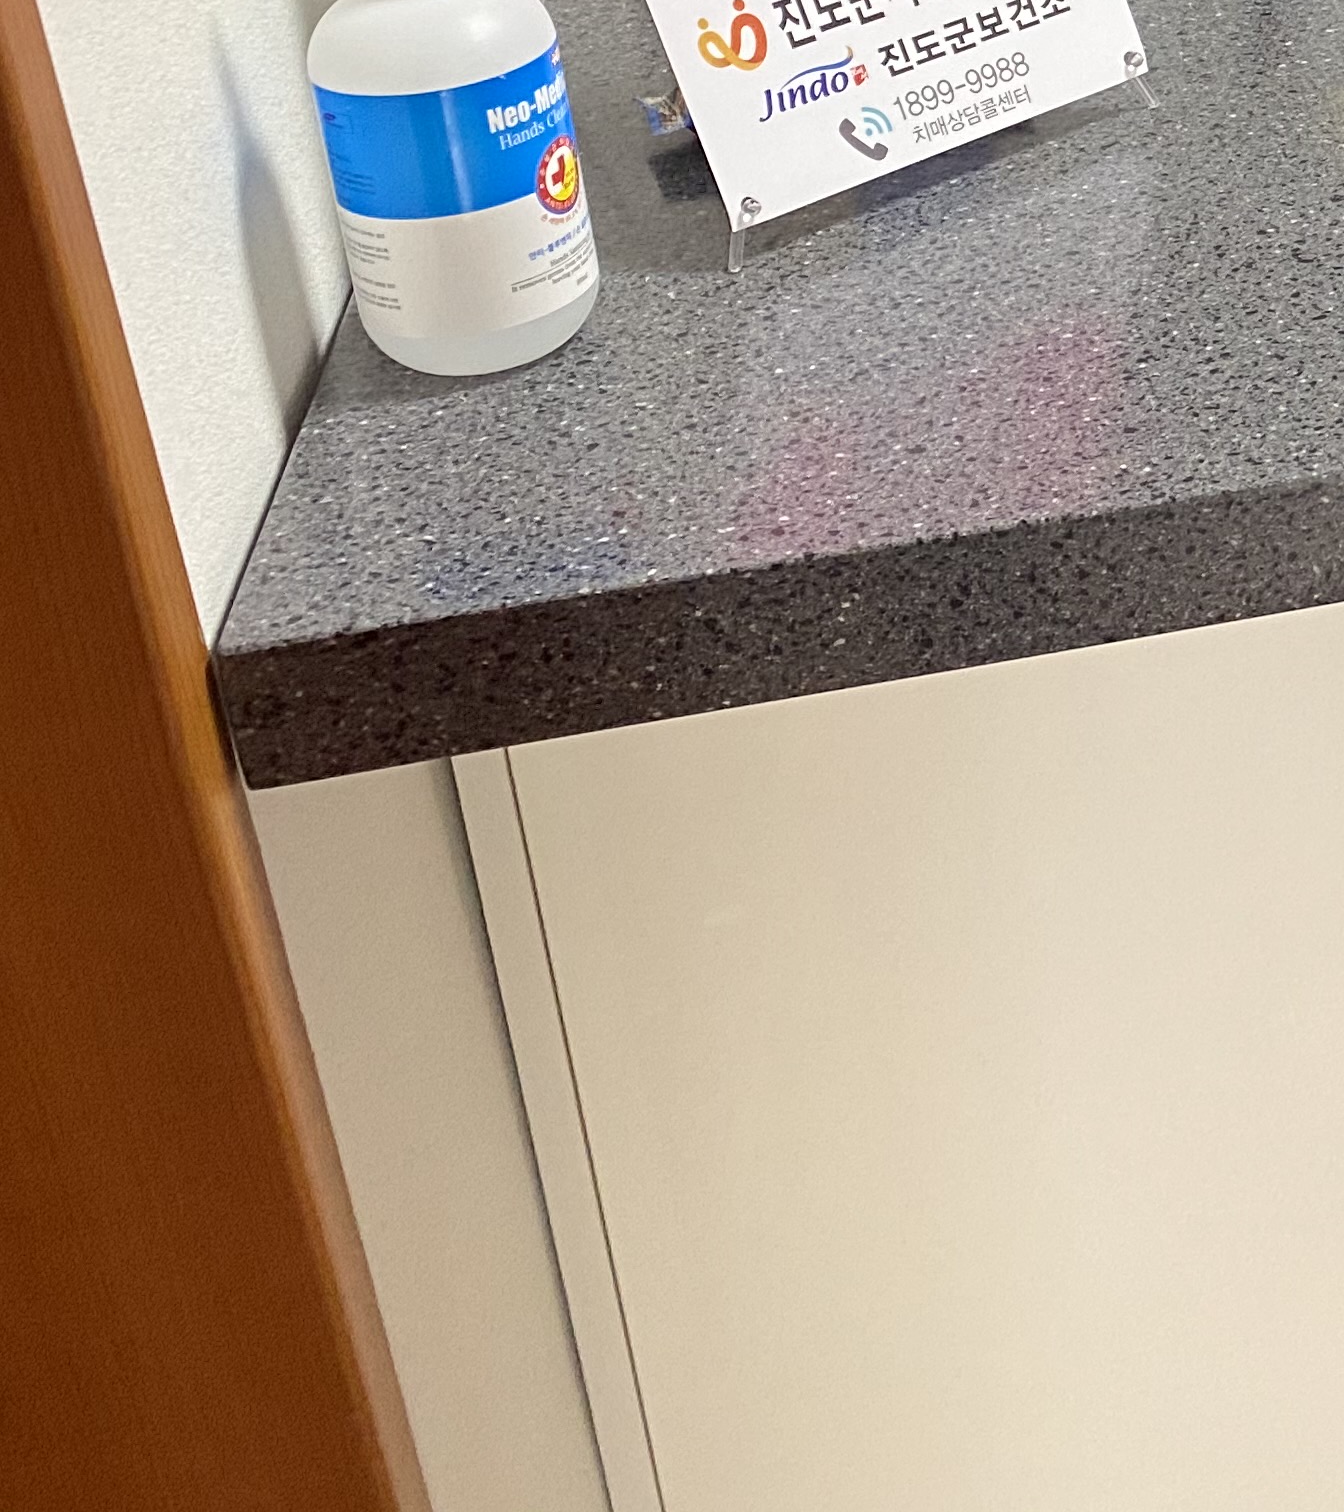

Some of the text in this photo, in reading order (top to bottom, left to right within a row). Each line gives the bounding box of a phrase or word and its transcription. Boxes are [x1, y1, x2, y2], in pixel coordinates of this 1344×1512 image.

[759, 71, 849, 122] Jindo
[893, 52, 1030, 121] 1899-9988
[912, 84, 1031, 143] 치매상담콜센터
[500, 121, 545, 150] Hands
